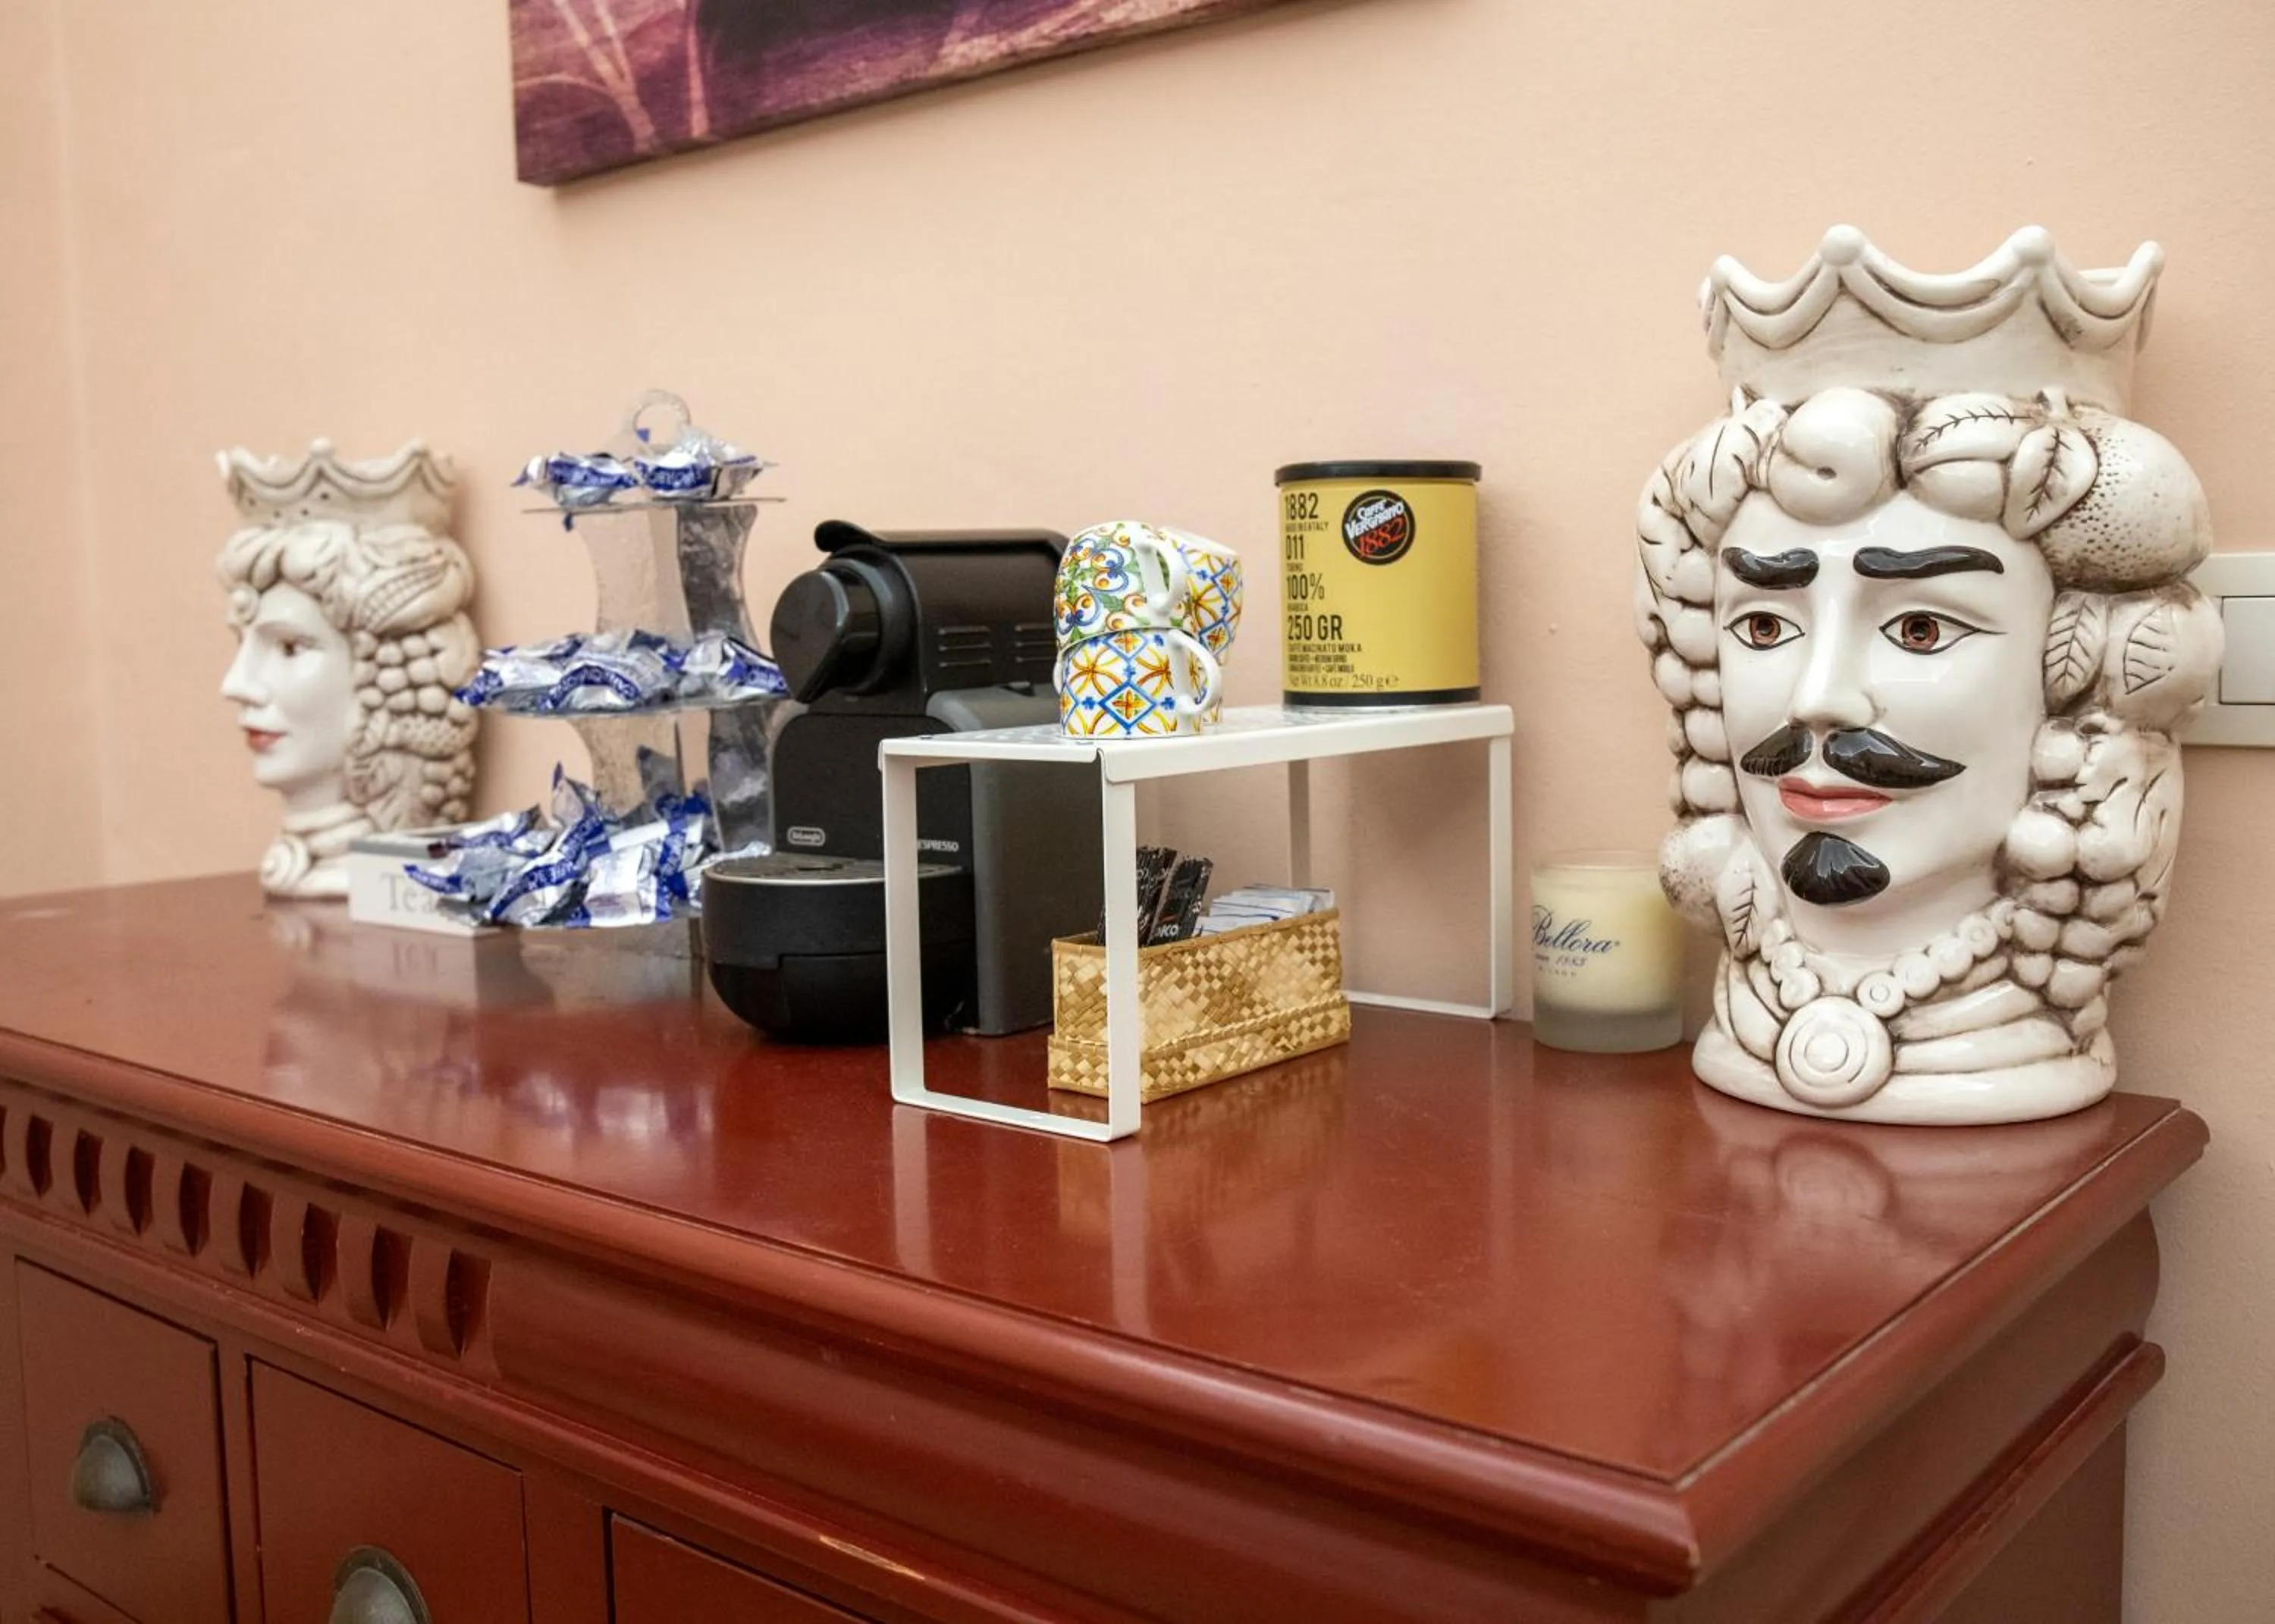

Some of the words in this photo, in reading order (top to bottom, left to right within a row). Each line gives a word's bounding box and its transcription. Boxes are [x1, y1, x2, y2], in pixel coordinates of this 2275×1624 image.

[1285, 492, 1318, 520] 1882
[1285, 534, 1304, 560] 011
[1358, 516, 1404, 557] 1882
[1286, 572, 1325, 600] 100%
[1288, 614, 1312, 641] 250
[1317, 614, 1342, 641] GR
[918, 839, 959, 852] ESPRESSO
[380, 873, 437, 914] Tea
